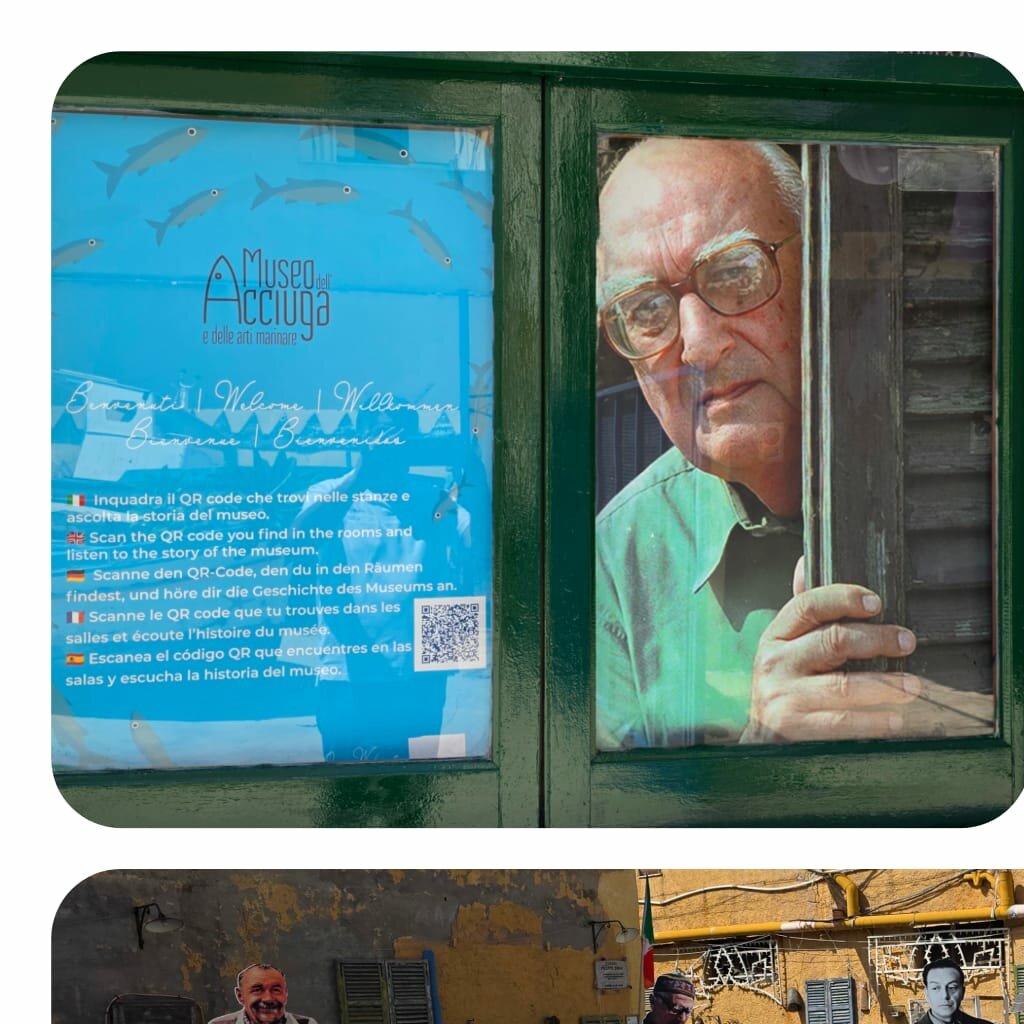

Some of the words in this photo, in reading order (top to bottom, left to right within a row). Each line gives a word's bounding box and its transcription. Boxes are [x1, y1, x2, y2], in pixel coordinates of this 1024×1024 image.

[243, 248, 314, 289] Museo
[203, 255, 330, 341] Acciuga
[202, 330, 209, 345] e
[211, 325, 234, 345] delle
[236, 329, 252, 345] arti
[256, 328, 297, 346] marinare
[66, 380, 185, 414] Benvenuti
[215, 379, 304, 413] Welcome
[334, 380, 459, 413] Willkommen
[126, 416, 241, 449] Bienvenue
[94, 493, 163, 507] Inquadra
[167, 493, 175, 505] il
[179, 493, 202, 506] QR
[206, 492, 242, 504] code
[246, 492, 273, 503] che
[277, 491, 310, 503] trovi
[314, 491, 348, 502] nelle
[352, 490, 398, 502] stanze
[401, 492, 410, 501] e
[66, 510, 121, 523] ascolta
[126, 509, 139, 522] la
[143, 509, 185, 522] storia
[189, 508, 212, 520] del
[216, 509, 270, 520] museo.
[89, 531, 127, 544] Scan
[131, 531, 156, 543] the
[160, 530, 183, 543] QR
[187, 529, 224, 542] code
[227, 530, 255, 544] you
[258, 528, 288, 540] find
[292, 528, 305, 539] in
[309, 528, 334, 539] the
[338, 528, 383, 538] rooms
[386, 526, 412, 537] and
[66, 548, 109, 561] listen
[113, 549, 128, 560] to
[133, 547, 157, 559] the
[161, 546, 199, 561] story
[203, 546, 218, 558] of
[222, 545, 246, 557] the
[251, 546, 319, 557] museum.
[93, 569, 150, 581] Scanne
[154, 567, 183, 580] den
[187, 566, 257, 580] QR-Code,
[260, 565, 288, 577] den
[293, 564, 311, 576] du
[316, 563, 329, 575] in
[333, 562, 360, 575] den
[364, 561, 423, 574] Räumen
[66, 590, 125, 603] findest,
[129, 588, 159, 601] und
[164, 587, 198, 600] höre
[202, 586, 222, 599] dir
[225, 586, 249, 598] die
[252, 585, 333, 597] Geschichte
[337, 583, 362, 595] des
[366, 582, 433, 594] Museums
[437, 581, 457, 592] an.
[89, 611, 146, 623] Scanne
[150, 609, 163, 621] le
[167, 608, 190, 621] QR
[194, 607, 230, 619] code
[234, 607, 262, 620] que
[266, 606, 282, 617] tu
[286, 605, 340, 616] trouves
[343, 602, 377, 614] dans
[381, 602, 401, 613] les
[65, 632, 109, 645] salles
[113, 632, 128, 643] et
[132, 628, 184, 642] écoute
[255, 625, 274, 637] du
[279, 624, 331, 636] musée.
[89, 652, 152, 665] Escanea
[156, 650, 169, 662] el
[173, 648, 224, 662] código
[228, 647, 251, 660] QR
[255, 647, 283, 659] que
[286, 644, 368, 657] encuentres
[371, 643, 389, 653] en
[393, 641, 412, 652] las
[65, 674, 104, 687] salas
[108, 676, 117, 688] y
[120, 671, 183, 684] escucha
[187, 670, 200, 681] la
[204, 667, 259, 680] historia
[263, 666, 285, 678] del
[290, 665, 342, 677] museo.
